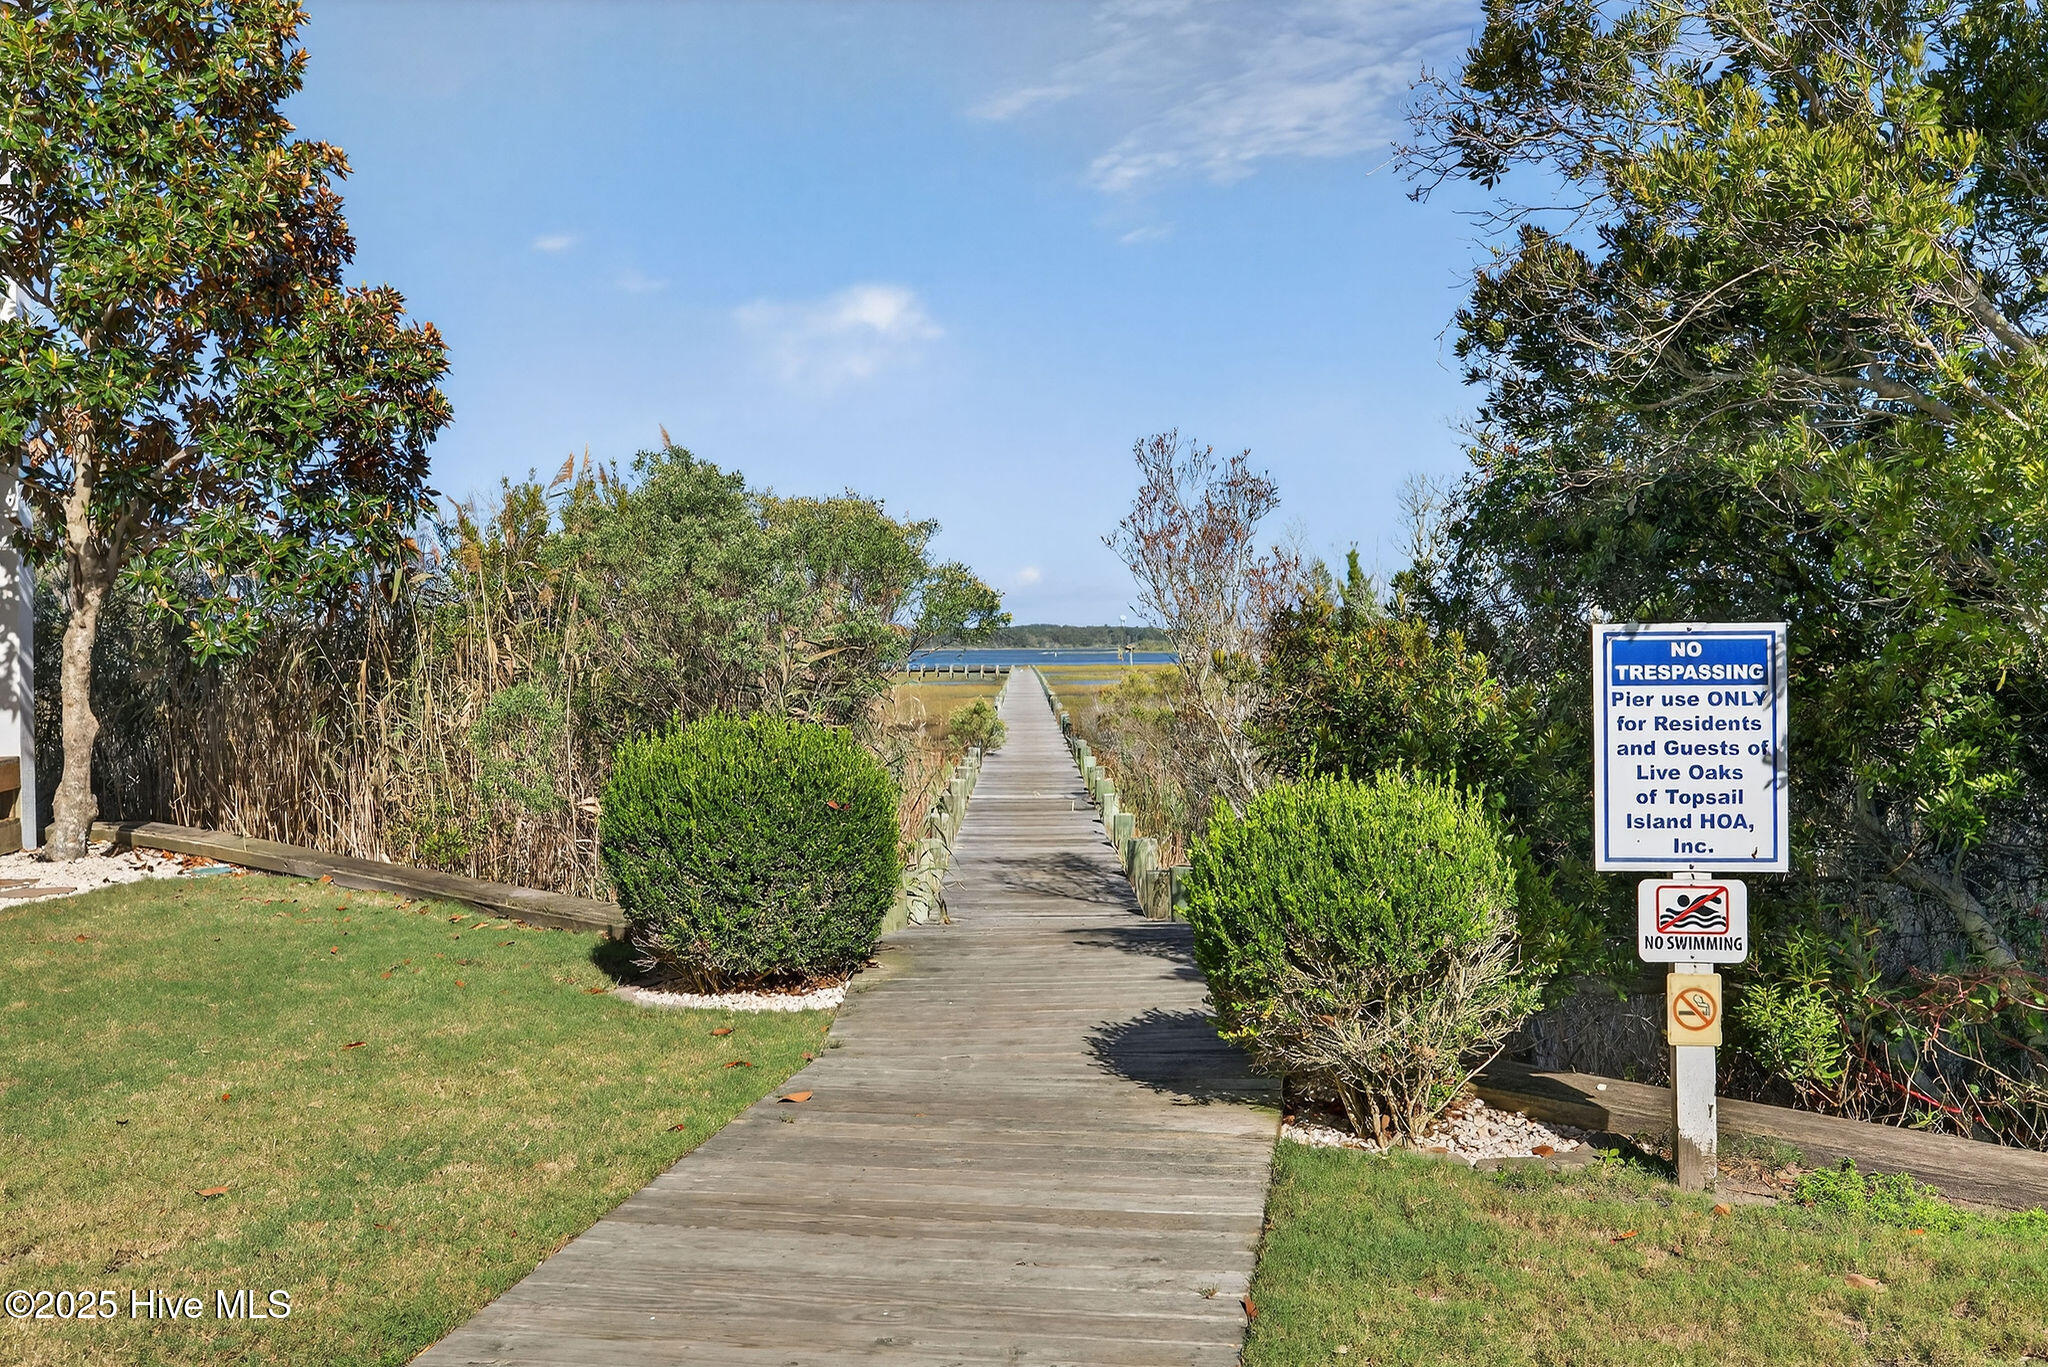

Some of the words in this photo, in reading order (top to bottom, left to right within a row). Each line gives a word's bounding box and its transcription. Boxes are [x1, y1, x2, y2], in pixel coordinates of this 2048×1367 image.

[1670, 641, 1702, 657] NO
[1614, 664, 1764, 681] TRESPASSING
[1611, 691, 1654, 707] Pier
[1662, 694, 1699, 707] use
[1707, 691, 1768, 707] ONLY
[1617, 716, 1646, 731] for
[1654, 716, 1762, 731] Residents
[1617, 741, 1656, 756] and
[1664, 740, 1740, 756] Guests
[1748, 740, 1769, 756] of
[1636, 765, 1681, 780] Live
[1688, 764, 1743, 780] Oaks
[1635, 789, 1657, 805] of
[1665, 789, 1743, 808] Topsail
[1626, 813, 1692, 829] Island
[1700, 813, 1754, 832] HOA,
[1673, 838, 1714, 854] Inc.
[1645, 935, 1663, 950] NO
[1667, 936, 1743, 951] SWIMMING
